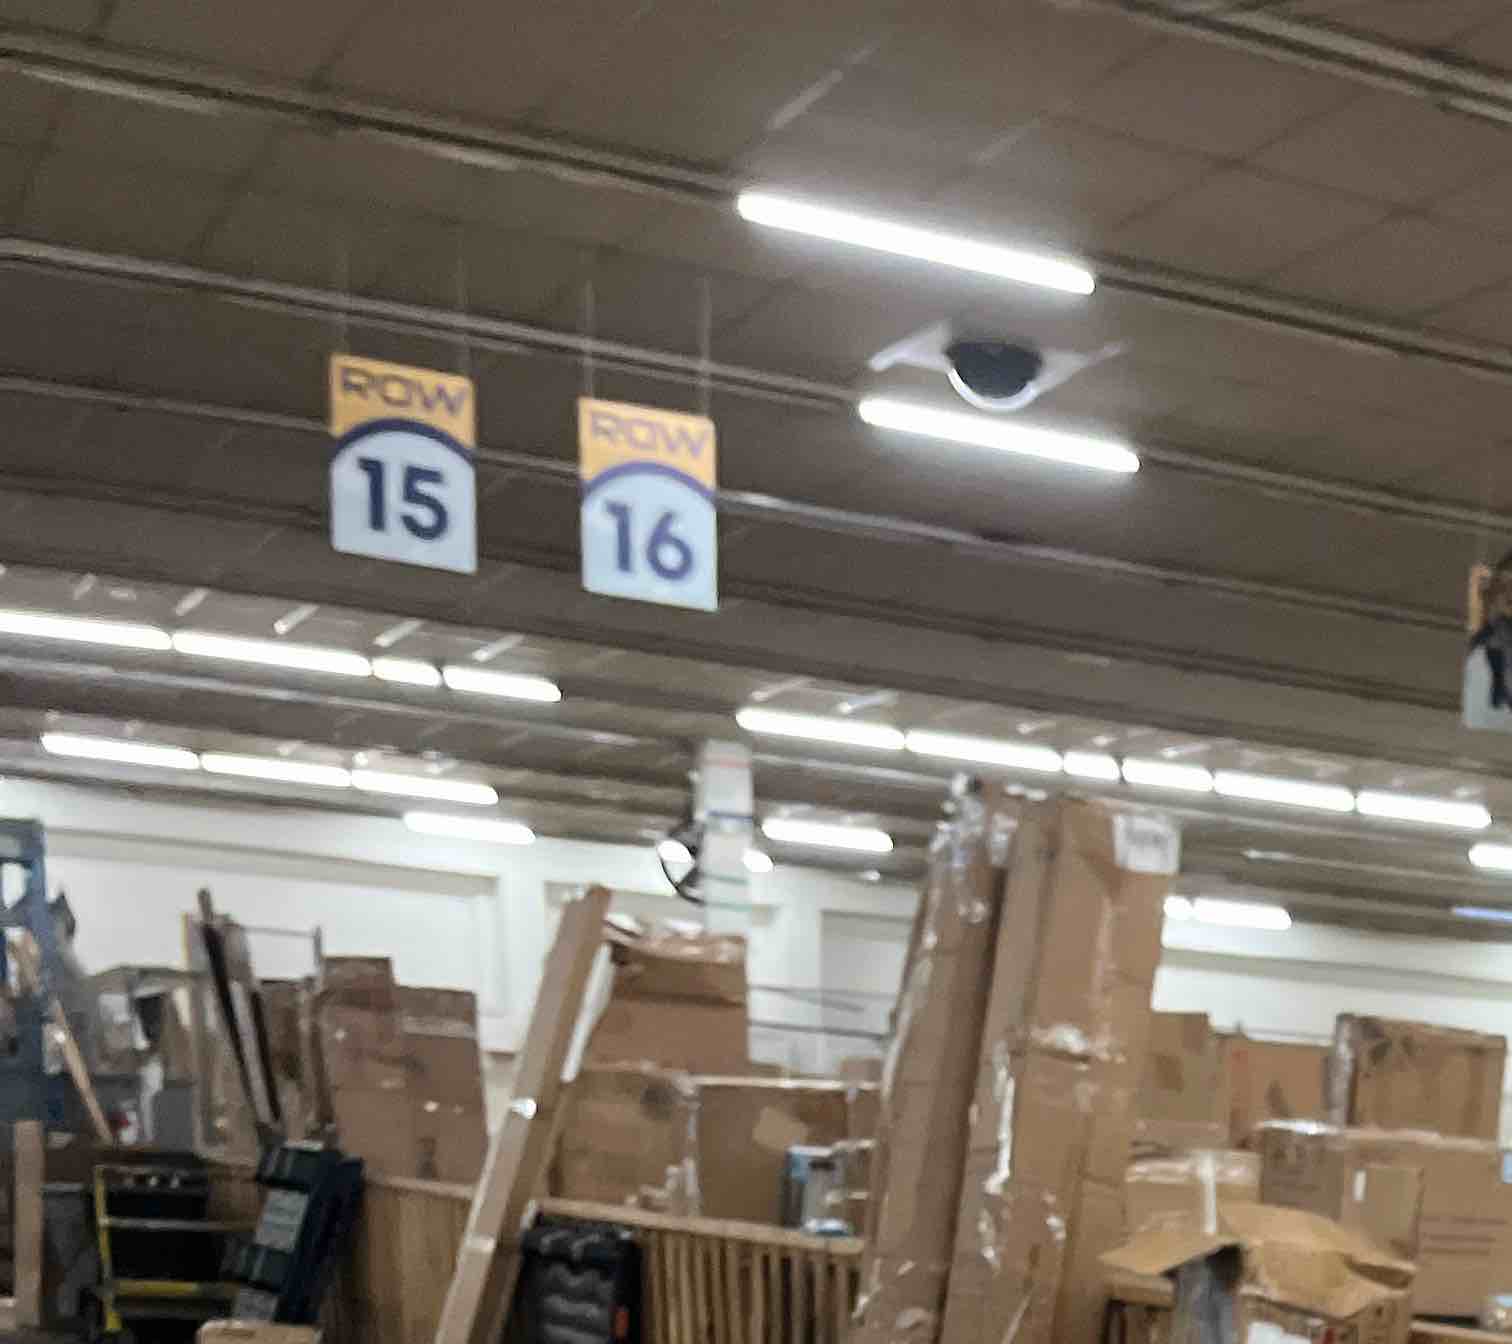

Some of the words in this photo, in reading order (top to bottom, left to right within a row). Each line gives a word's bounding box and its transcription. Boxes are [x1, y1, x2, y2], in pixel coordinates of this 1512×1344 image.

[340, 367, 466, 417] ROW
[589, 411, 708, 457] ROW
[357, 457, 449, 541] 15
[605, 500, 694, 581] 16
